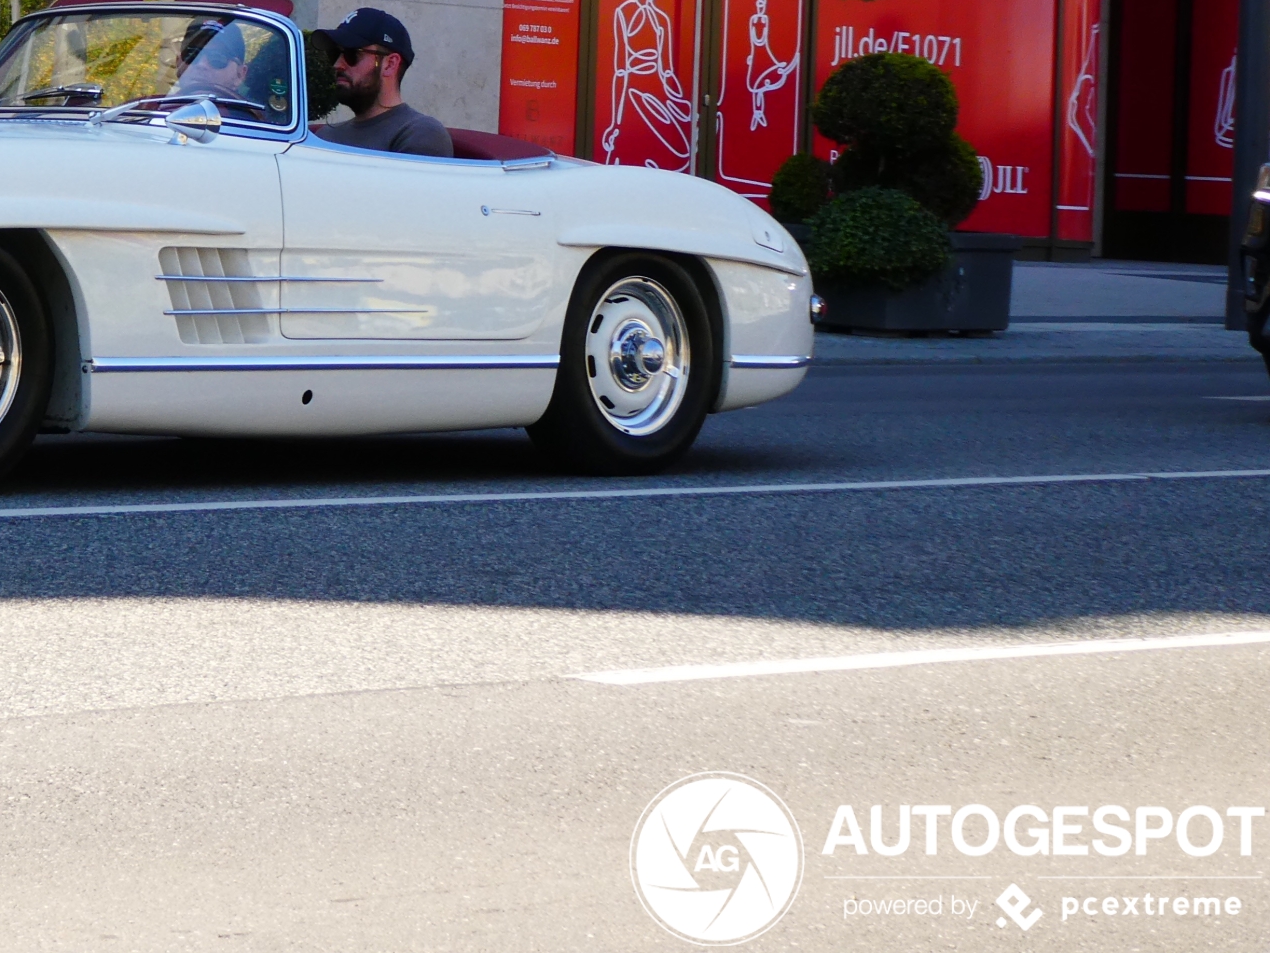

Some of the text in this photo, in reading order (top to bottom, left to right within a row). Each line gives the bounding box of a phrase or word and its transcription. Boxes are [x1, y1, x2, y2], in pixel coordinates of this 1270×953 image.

[510, 79, 557, 89] Vermietung durch
[993, 165, 1028, 194] JLL
